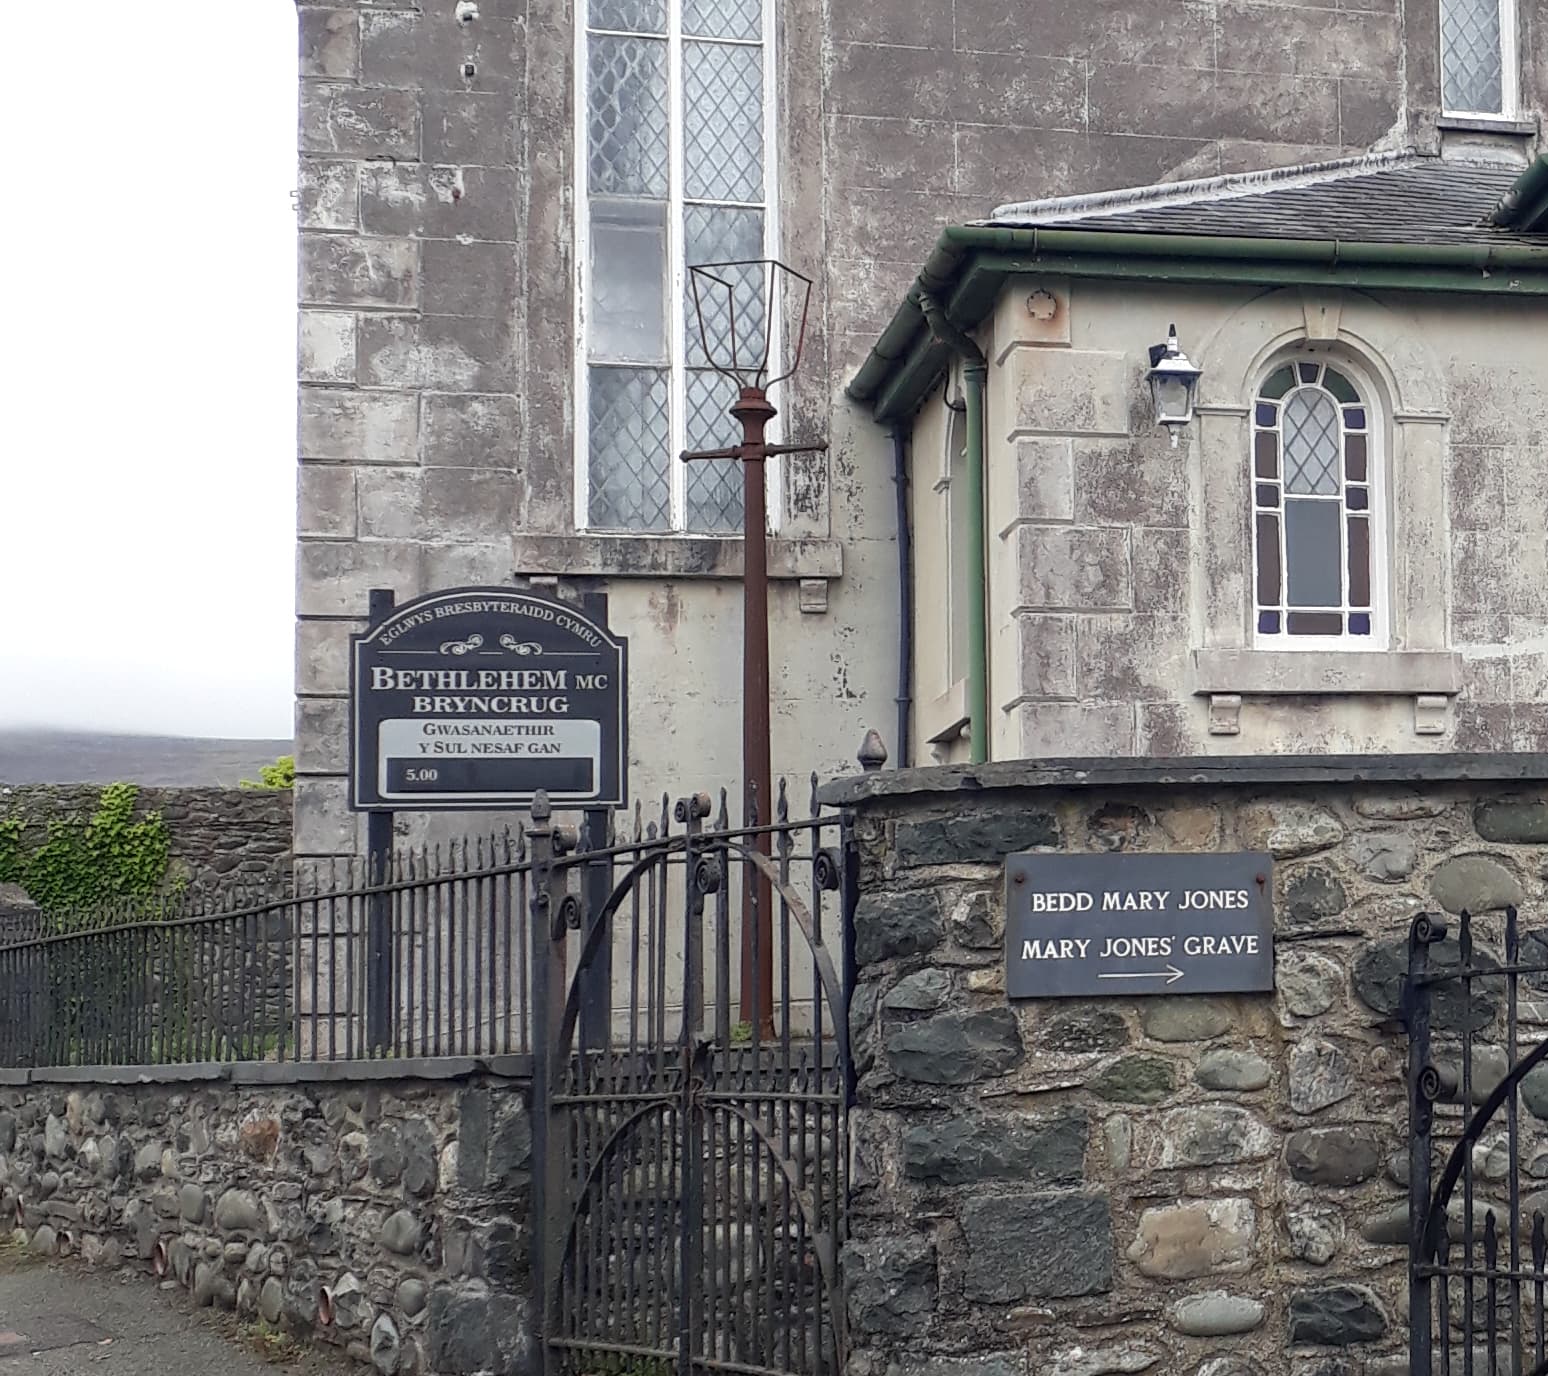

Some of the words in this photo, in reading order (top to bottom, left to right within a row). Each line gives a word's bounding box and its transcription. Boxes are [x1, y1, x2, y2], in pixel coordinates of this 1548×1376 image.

[379, 611, 433, 646] EGLWYS
[435, 601, 554, 621] BRESBYTERAIDD
[556, 615, 602, 648] CYMRU
[371, 667, 567, 690] BETHLEHEM
[575, 674, 608, 690] MC
[412, 696, 570, 713] BRYNCRUG
[422, 723, 555, 736] GWASANAETHIR
[419, 742, 430, 754] Y
[433, 741, 467, 754] SUL
[471, 743, 525, 754] NESAF
[528, 742, 561, 754] GAN
[405, 769, 438, 781] 5.00
[1032, 892, 1093, 912] BEDD
[1101, 890, 1170, 911] MARY
[1178, 889, 1249, 910] JONES
[1021, 939, 1091, 960] MARY
[1184, 935, 1259, 955] GRAVE
